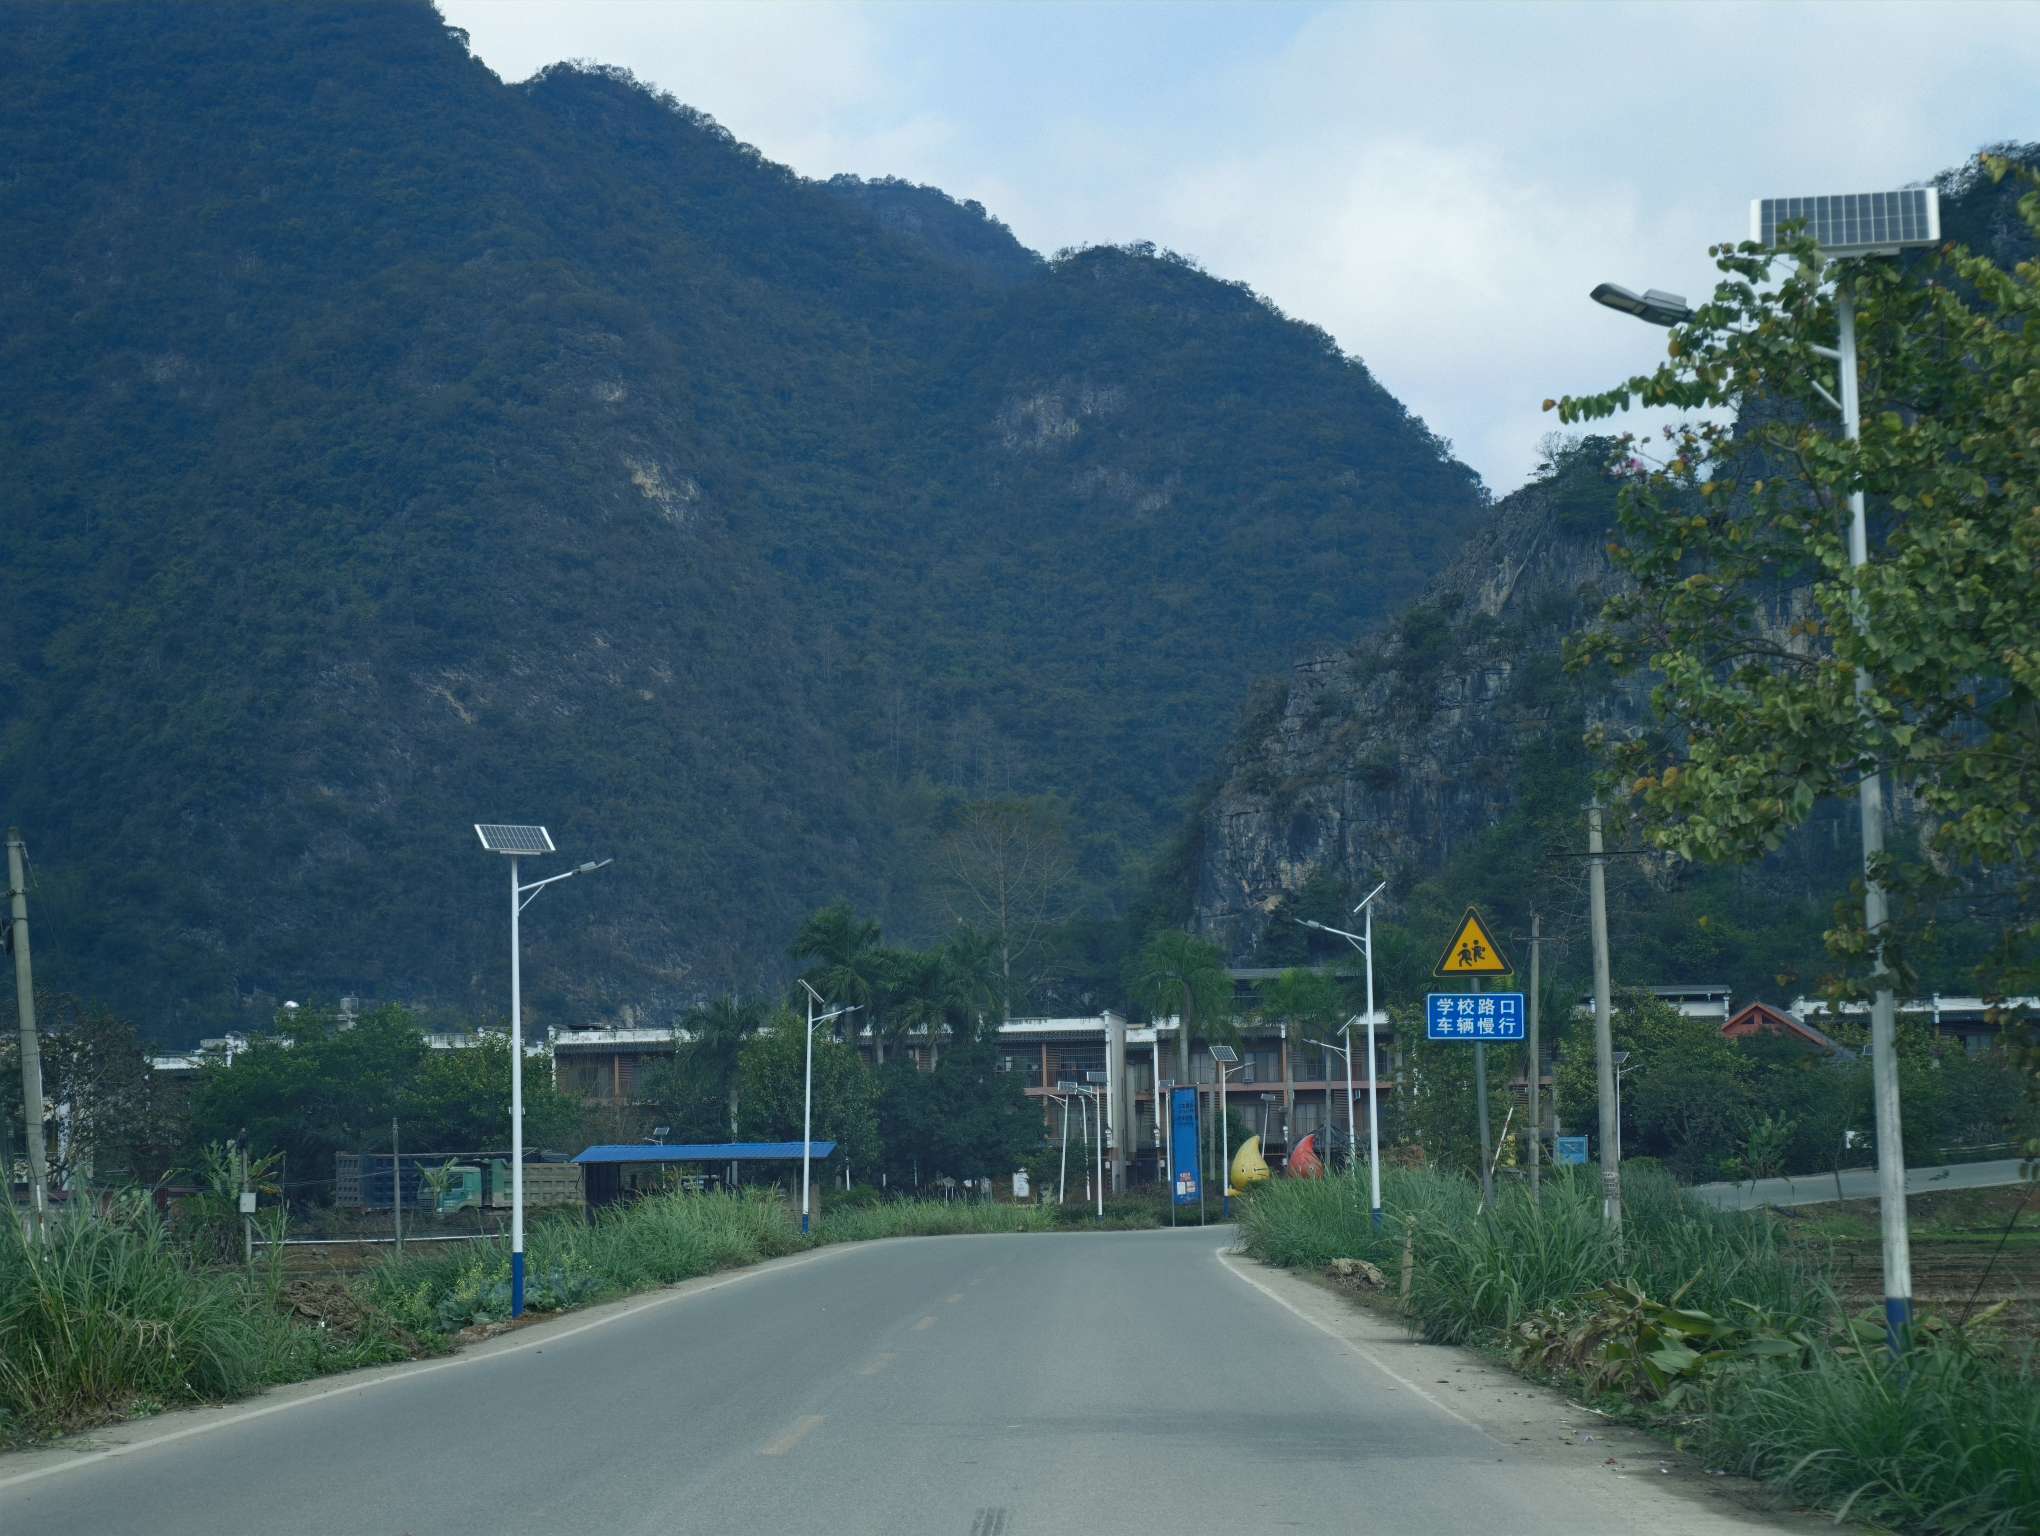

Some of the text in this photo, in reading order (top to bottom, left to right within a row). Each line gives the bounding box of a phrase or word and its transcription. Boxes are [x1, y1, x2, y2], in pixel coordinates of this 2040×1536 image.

[1436, 998, 1515, 1015] 学校路口
[1436, 1017, 1516, 1035] 车辆慢行
